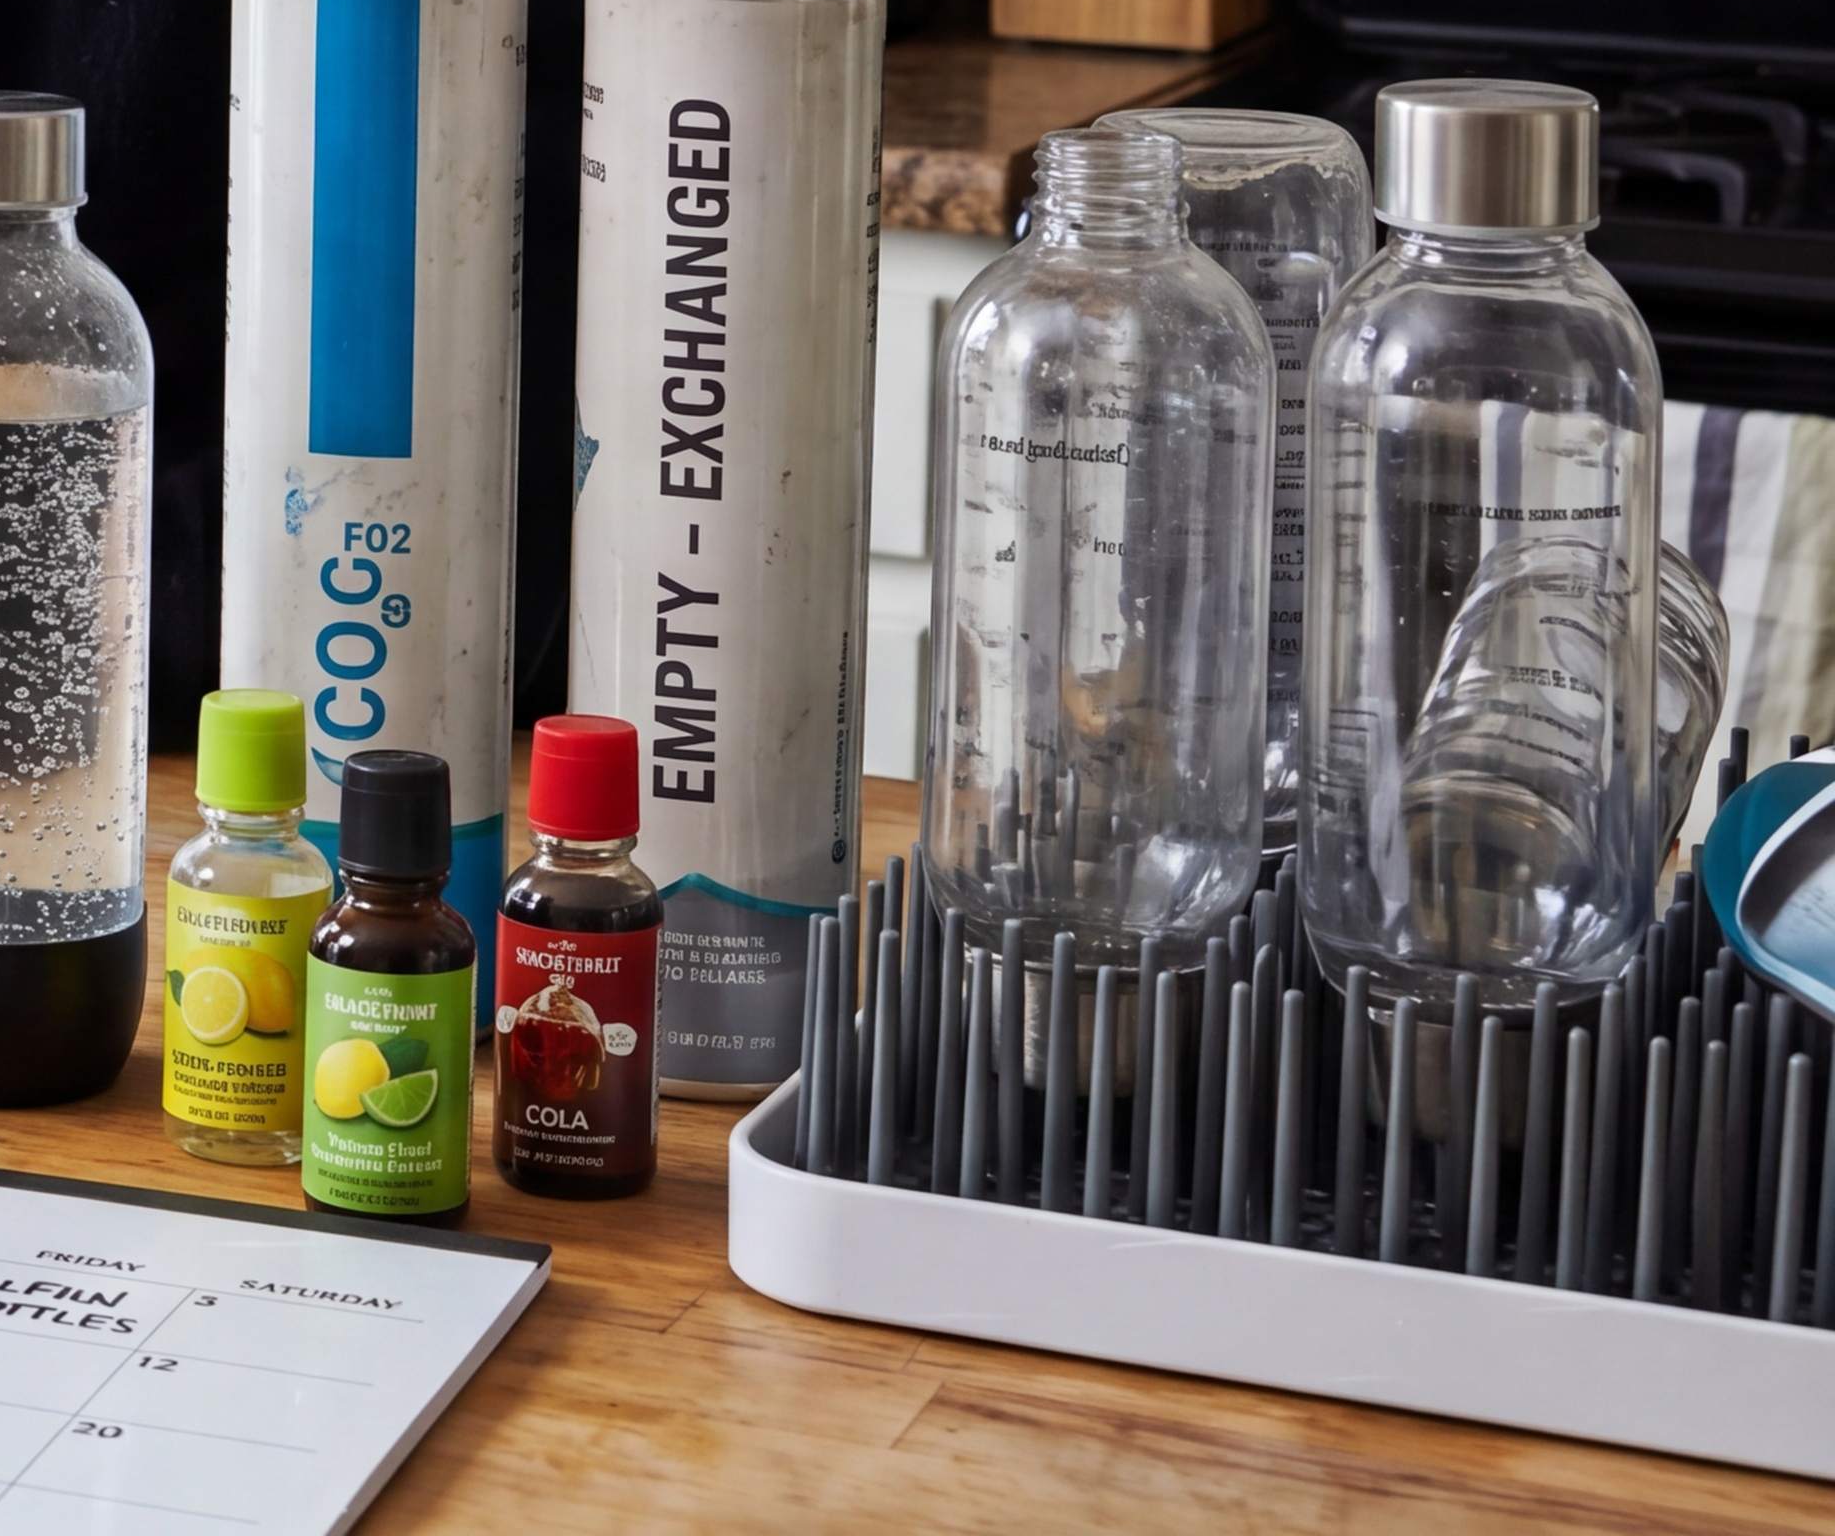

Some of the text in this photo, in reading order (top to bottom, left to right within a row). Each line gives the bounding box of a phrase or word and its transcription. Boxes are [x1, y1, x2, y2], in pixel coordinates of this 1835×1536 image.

[659, 96, 732, 502] EXCHANGED
[651, 570, 722, 806] EMPTY
[525, 1104, 590, 1131] COLA
[238, 1279, 404, 1310] SATURDAY
[137, 1355, 179, 1373] 12
[71, 1421, 125, 1440] 20
